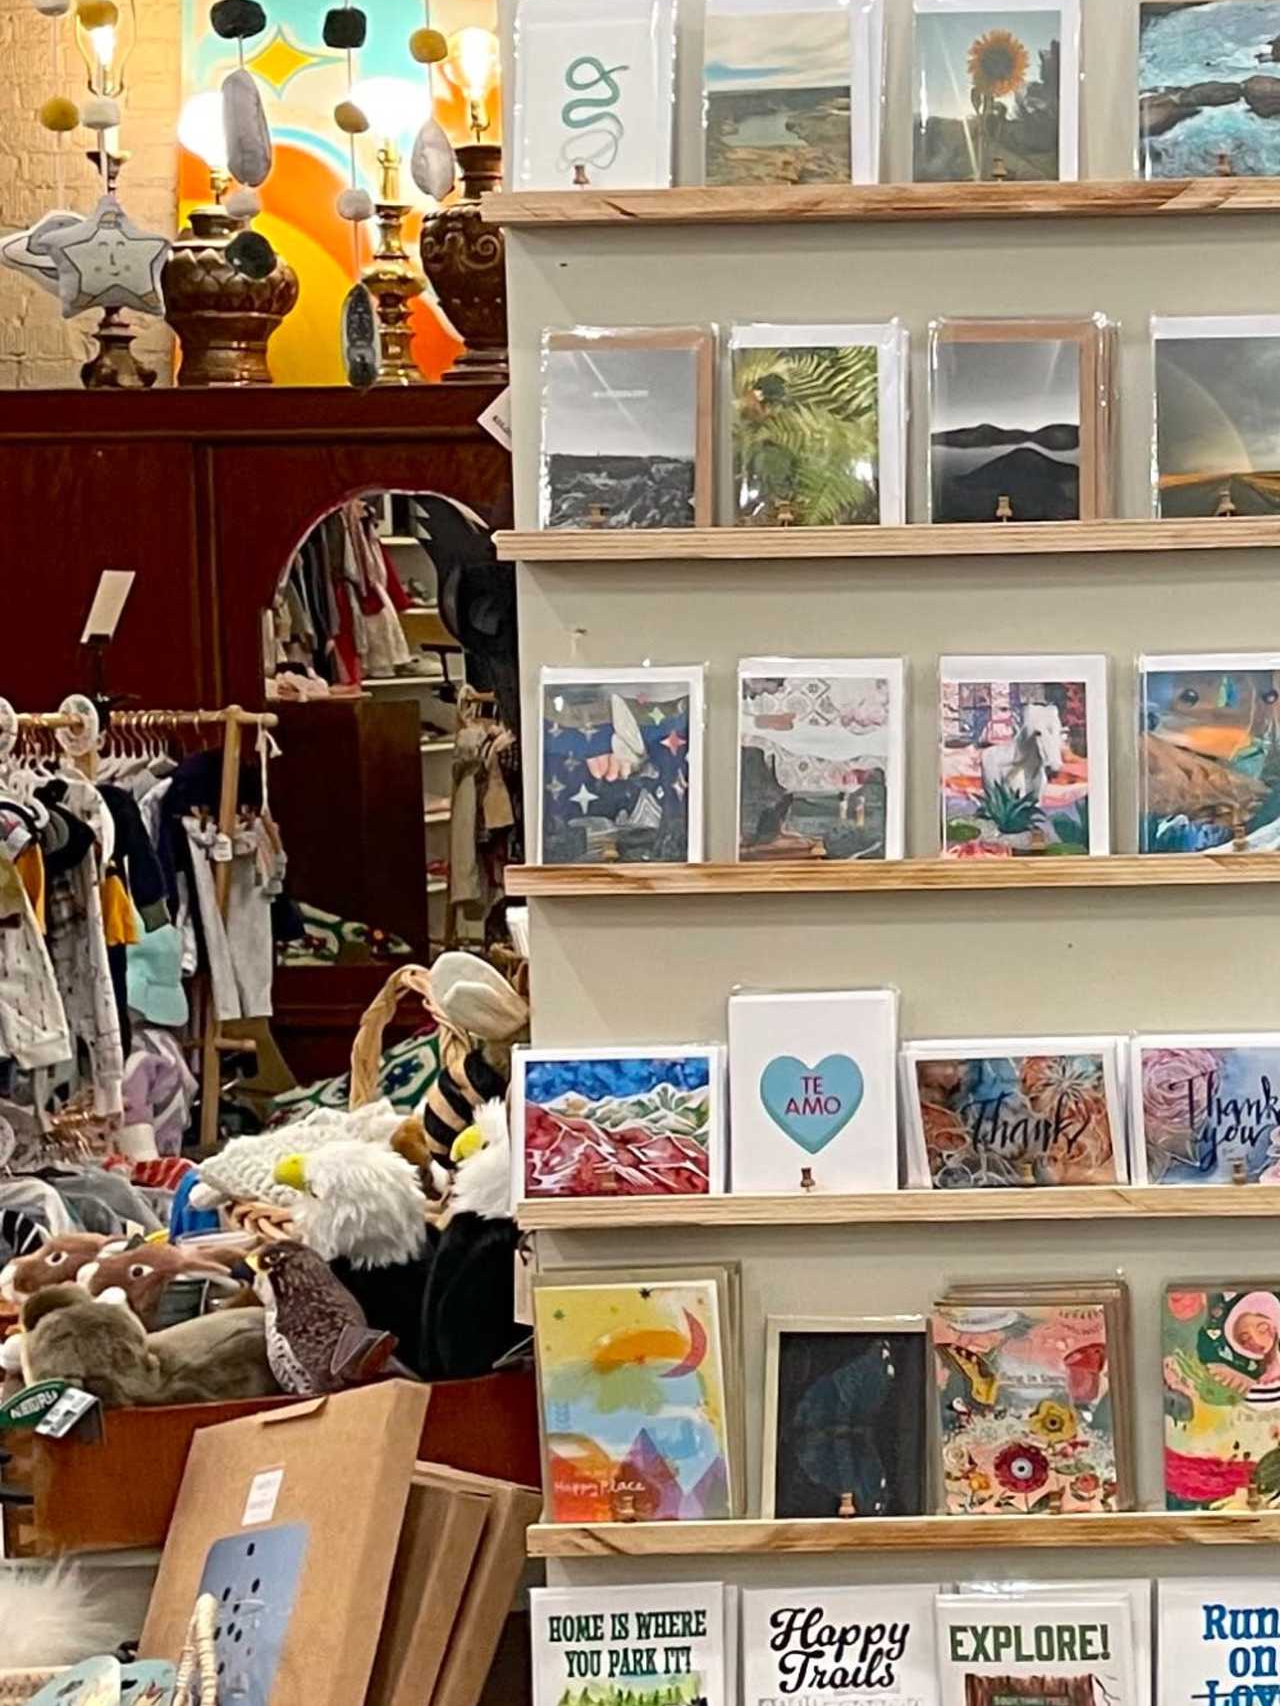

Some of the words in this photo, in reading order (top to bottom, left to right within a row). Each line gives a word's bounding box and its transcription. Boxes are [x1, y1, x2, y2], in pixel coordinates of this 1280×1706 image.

[801, 1075, 824, 1093] TE
[784, 1094, 841, 1117] AMO
[963, 1091, 1090, 1155] Thank
[1198, 1123, 1280, 1171] you
[548, 1614, 605, 1643] HOME
[610, 1612, 629, 1640] IS
[635, 1609, 708, 1639] WHERE
[769, 1606, 911, 1662] Happy
[949, 1622, 1112, 1663] EXPLORE!
[564, 1649, 601, 1678] YOU
[608, 1646, 660, 1677] PARK
[663, 1645, 692, 1675] IT!
[778, 1648, 896, 1694] Trails
[1228, 1646, 1278, 1678] on
